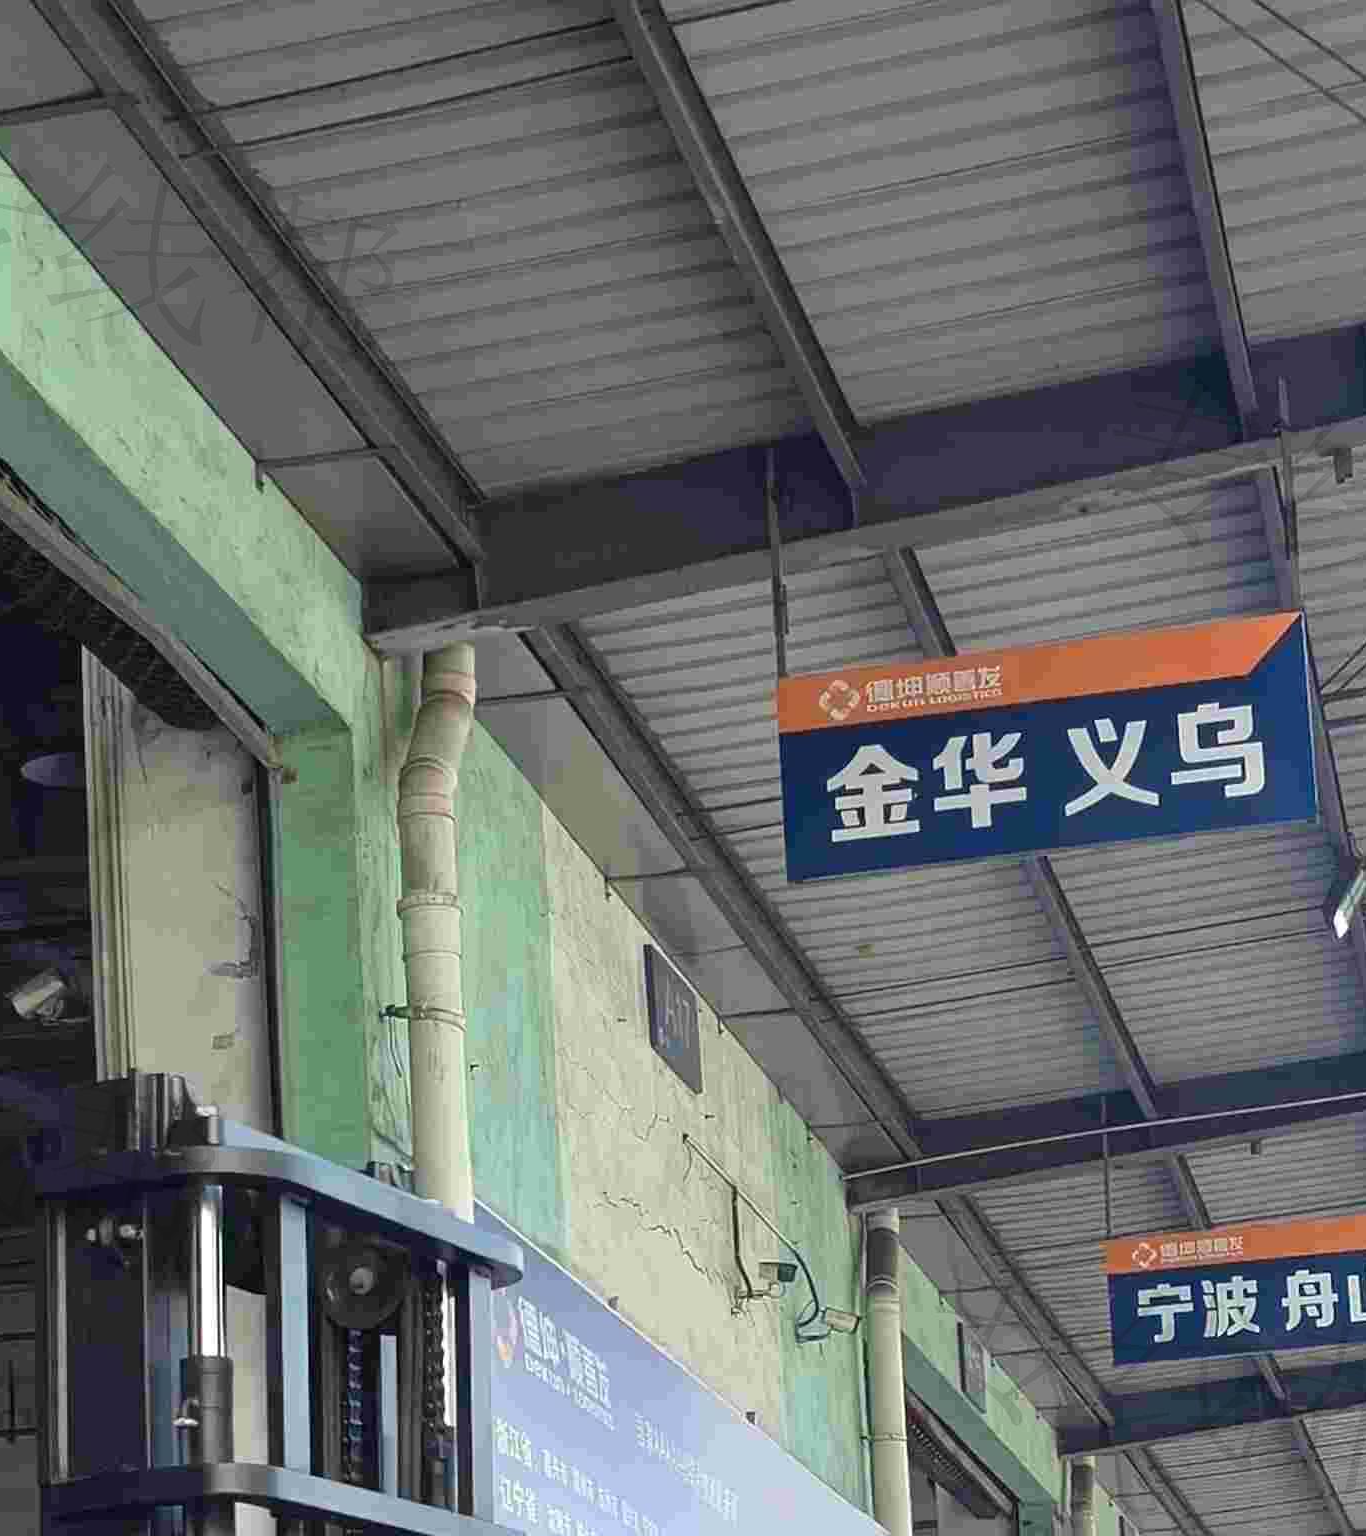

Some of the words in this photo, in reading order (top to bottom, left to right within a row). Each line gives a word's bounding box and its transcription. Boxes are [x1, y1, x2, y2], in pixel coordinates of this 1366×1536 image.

[826, 731, 1028, 843] 金华
[1064, 701, 1267, 817] 义乌
[1136, 1275, 1260, 1343] 宁波
